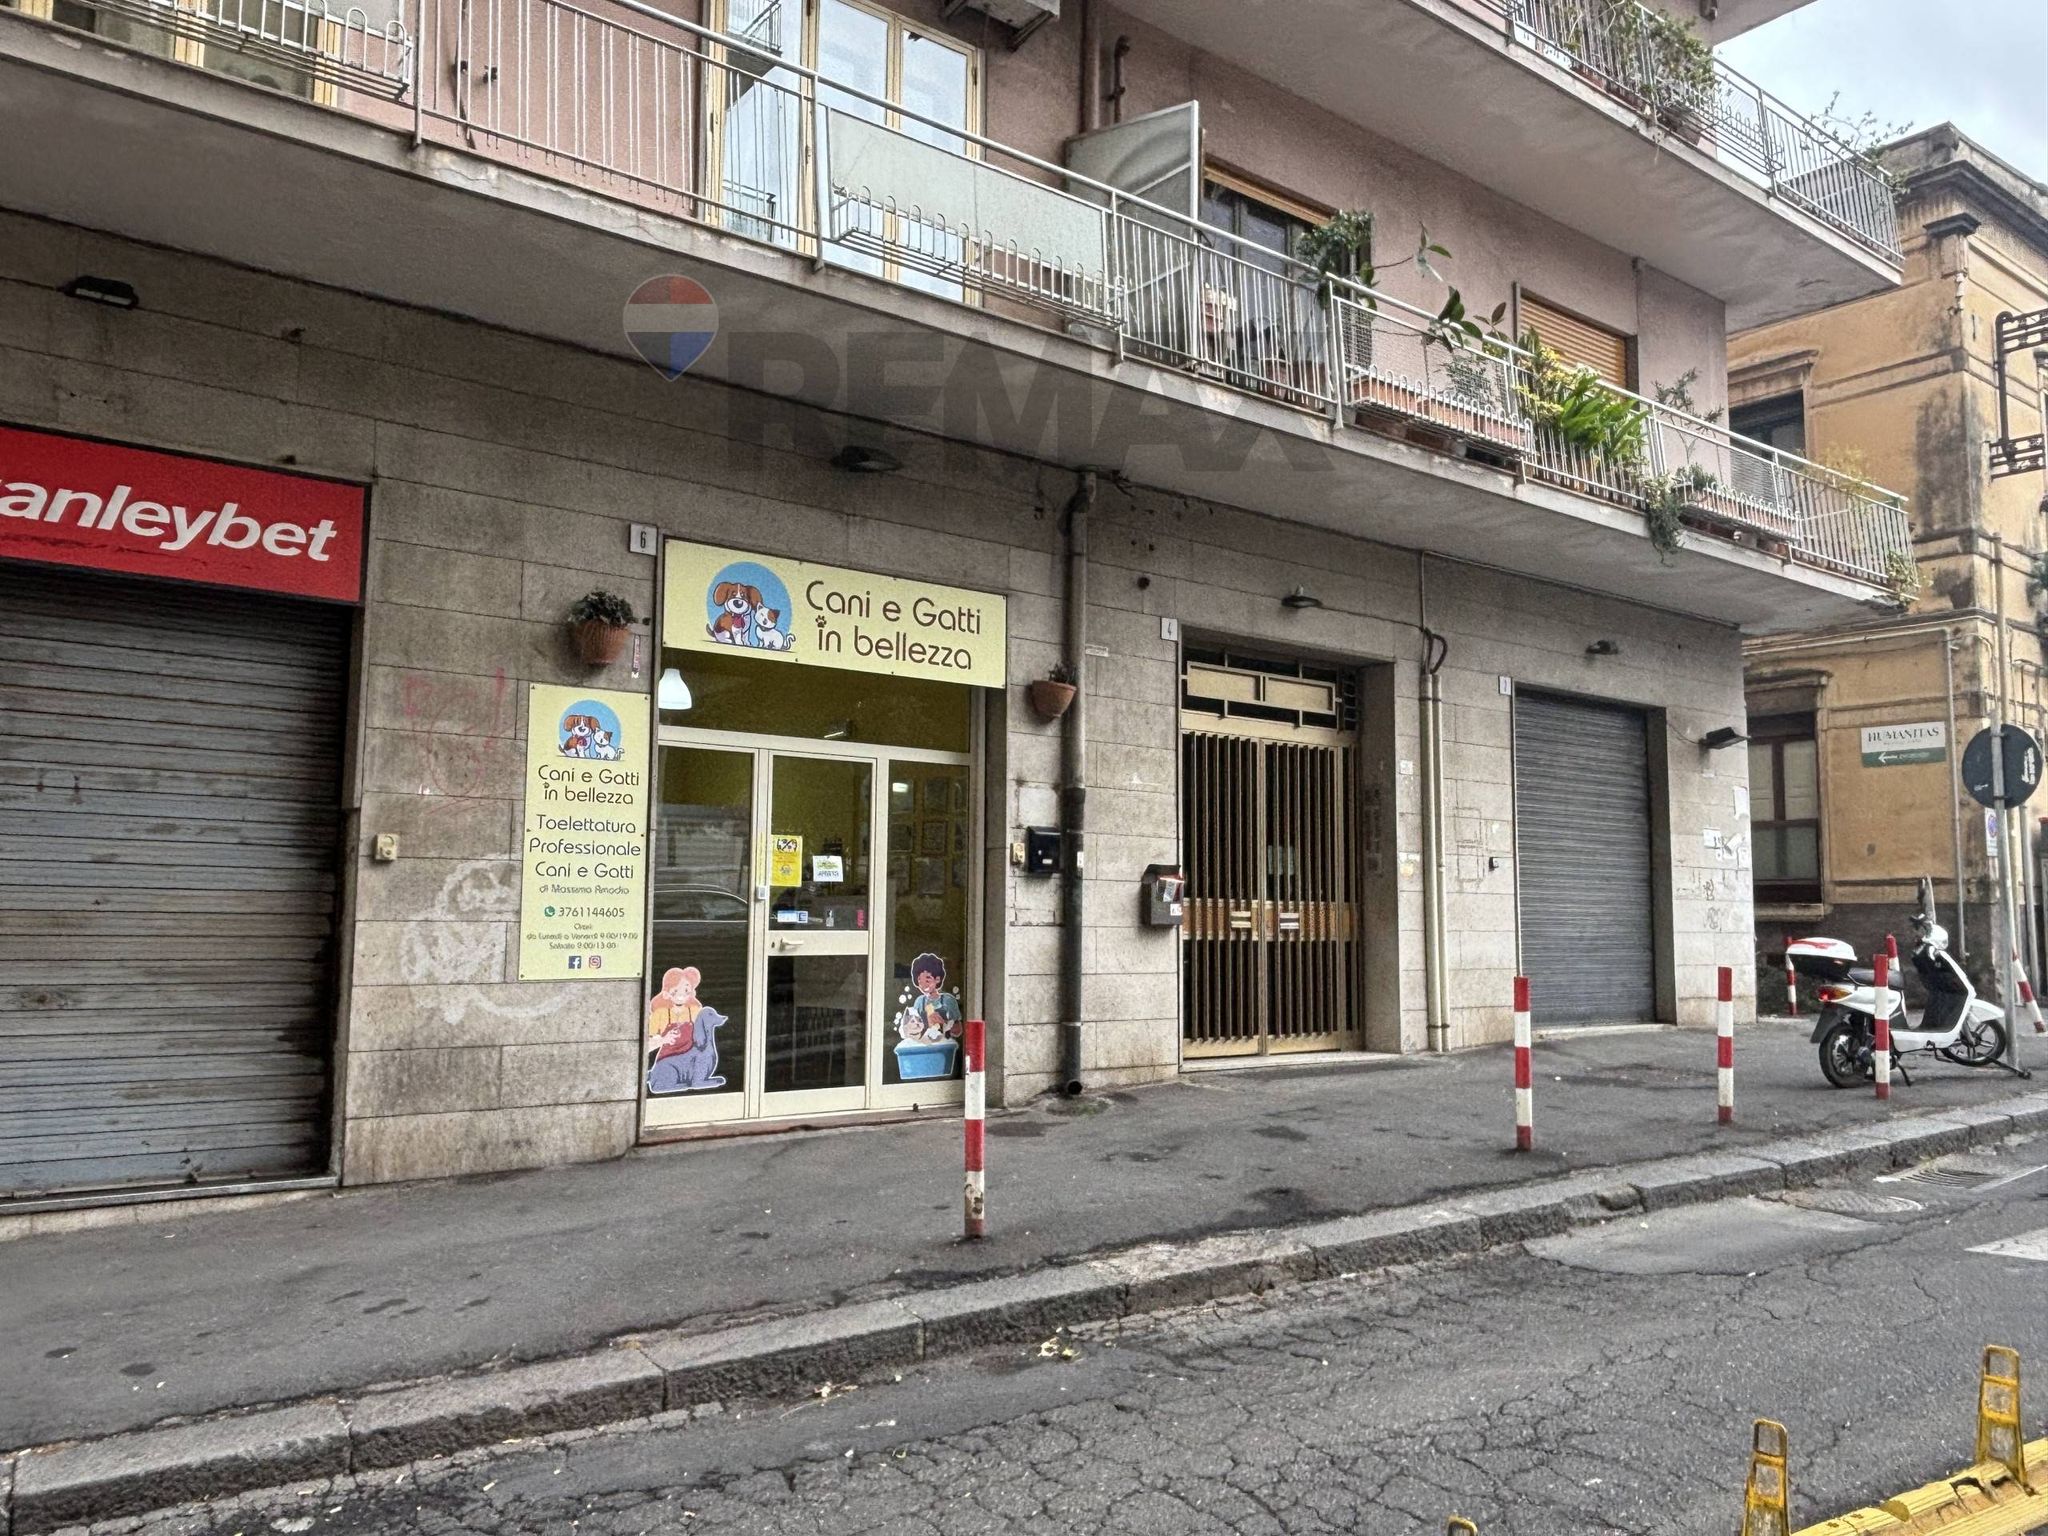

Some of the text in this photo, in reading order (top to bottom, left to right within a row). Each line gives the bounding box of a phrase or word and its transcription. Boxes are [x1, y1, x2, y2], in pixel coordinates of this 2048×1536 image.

[0, 481, 338, 562] anleybet
[640, 530, 647, 549] 6
[805, 580, 982, 636] Cani e Gatti
[815, 615, 973, 671] in bellezza
[1868, 727, 1939, 742] HUMANITAS
[538, 764, 640, 786] Cani e Gatti
[543, 781, 634, 805] in bellezza
[536, 813, 636, 834] Toelettatura
[529, 837, 641, 857] Professionale
[535, 861, 634, 879] Cani e Gatti
[539, 884, 548, 894] di
[551, 884, 592, 894] Massimo
[558, 906, 625, 918] 3761144605
